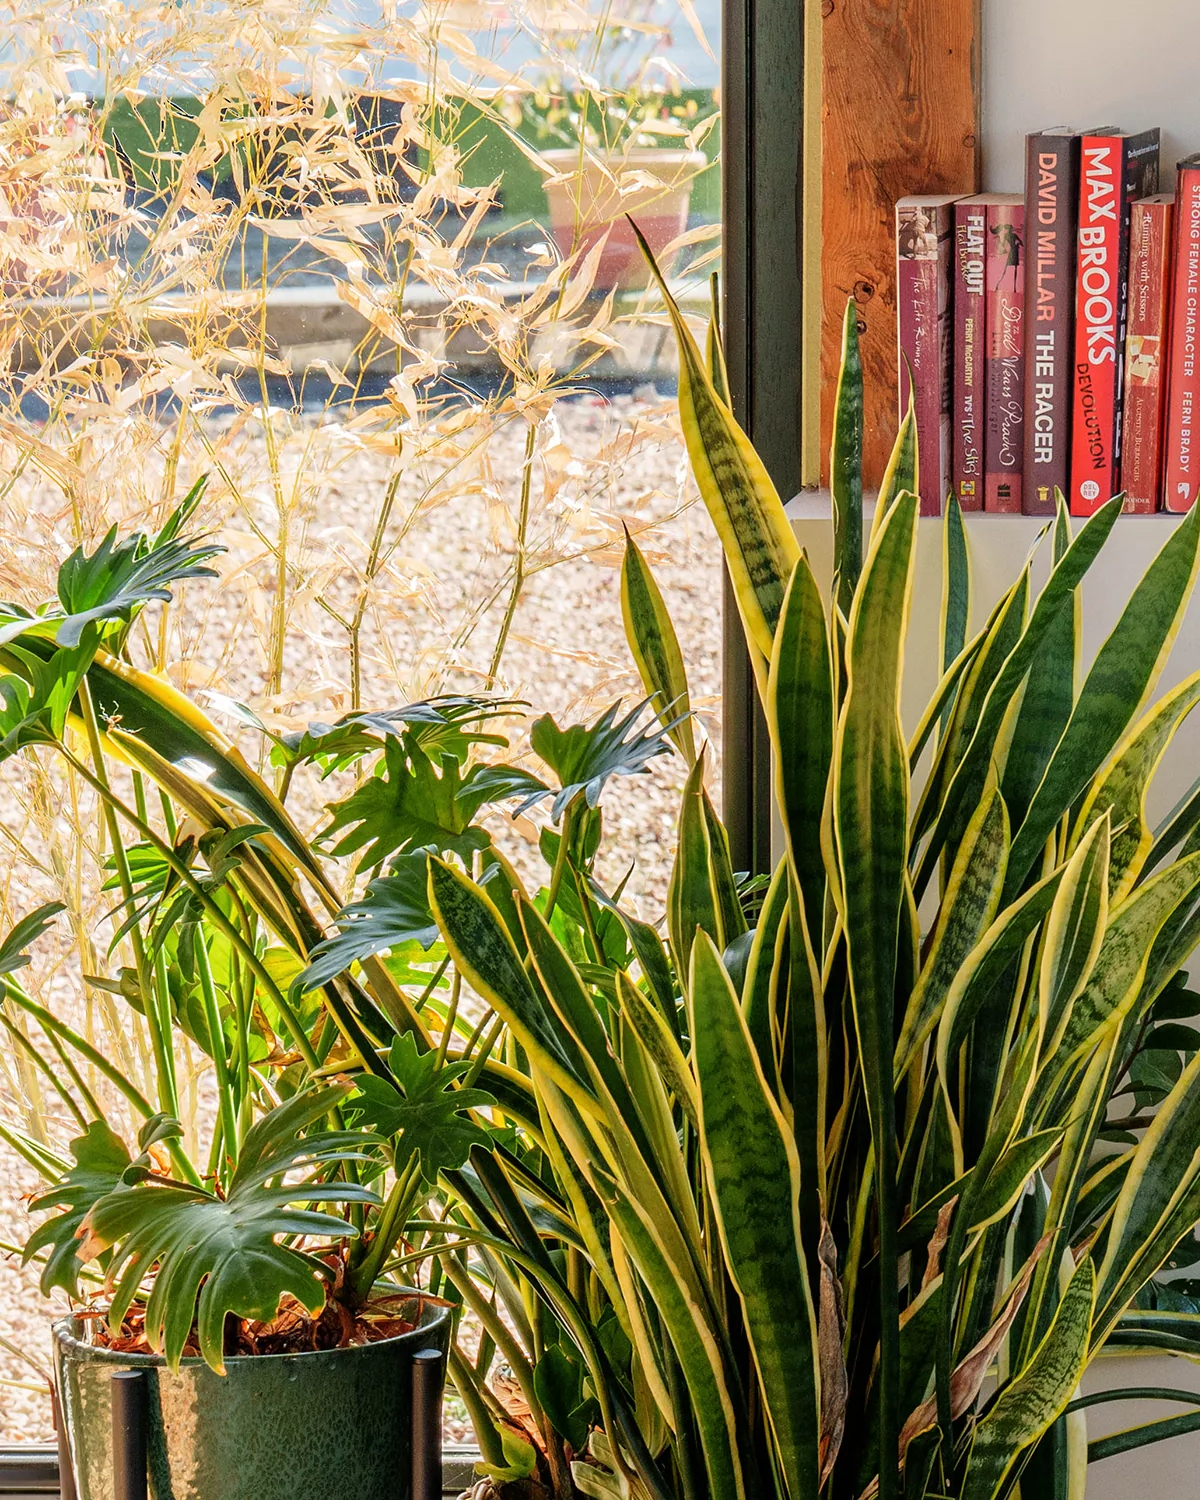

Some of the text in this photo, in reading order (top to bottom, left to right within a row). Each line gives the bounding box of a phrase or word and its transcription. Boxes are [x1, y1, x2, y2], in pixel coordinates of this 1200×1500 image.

[1080, 147, 1116, 365] MAX BROOKS
[1138, 214, 1152, 321] Running with Scissors
[1187, 243, 1199, 293] FEMALE
[911, 269, 927, 370] The Kite Runner
[1035, 153, 1057, 463] DAVID MILLAR THE RACER
[1184, 298, 1197, 376] CHARACTER
[1077, 363, 1106, 469] DEVOLUTION
[1180, 429, 1190, 472] BRADY
[1182, 392, 1192, 424] FERN
